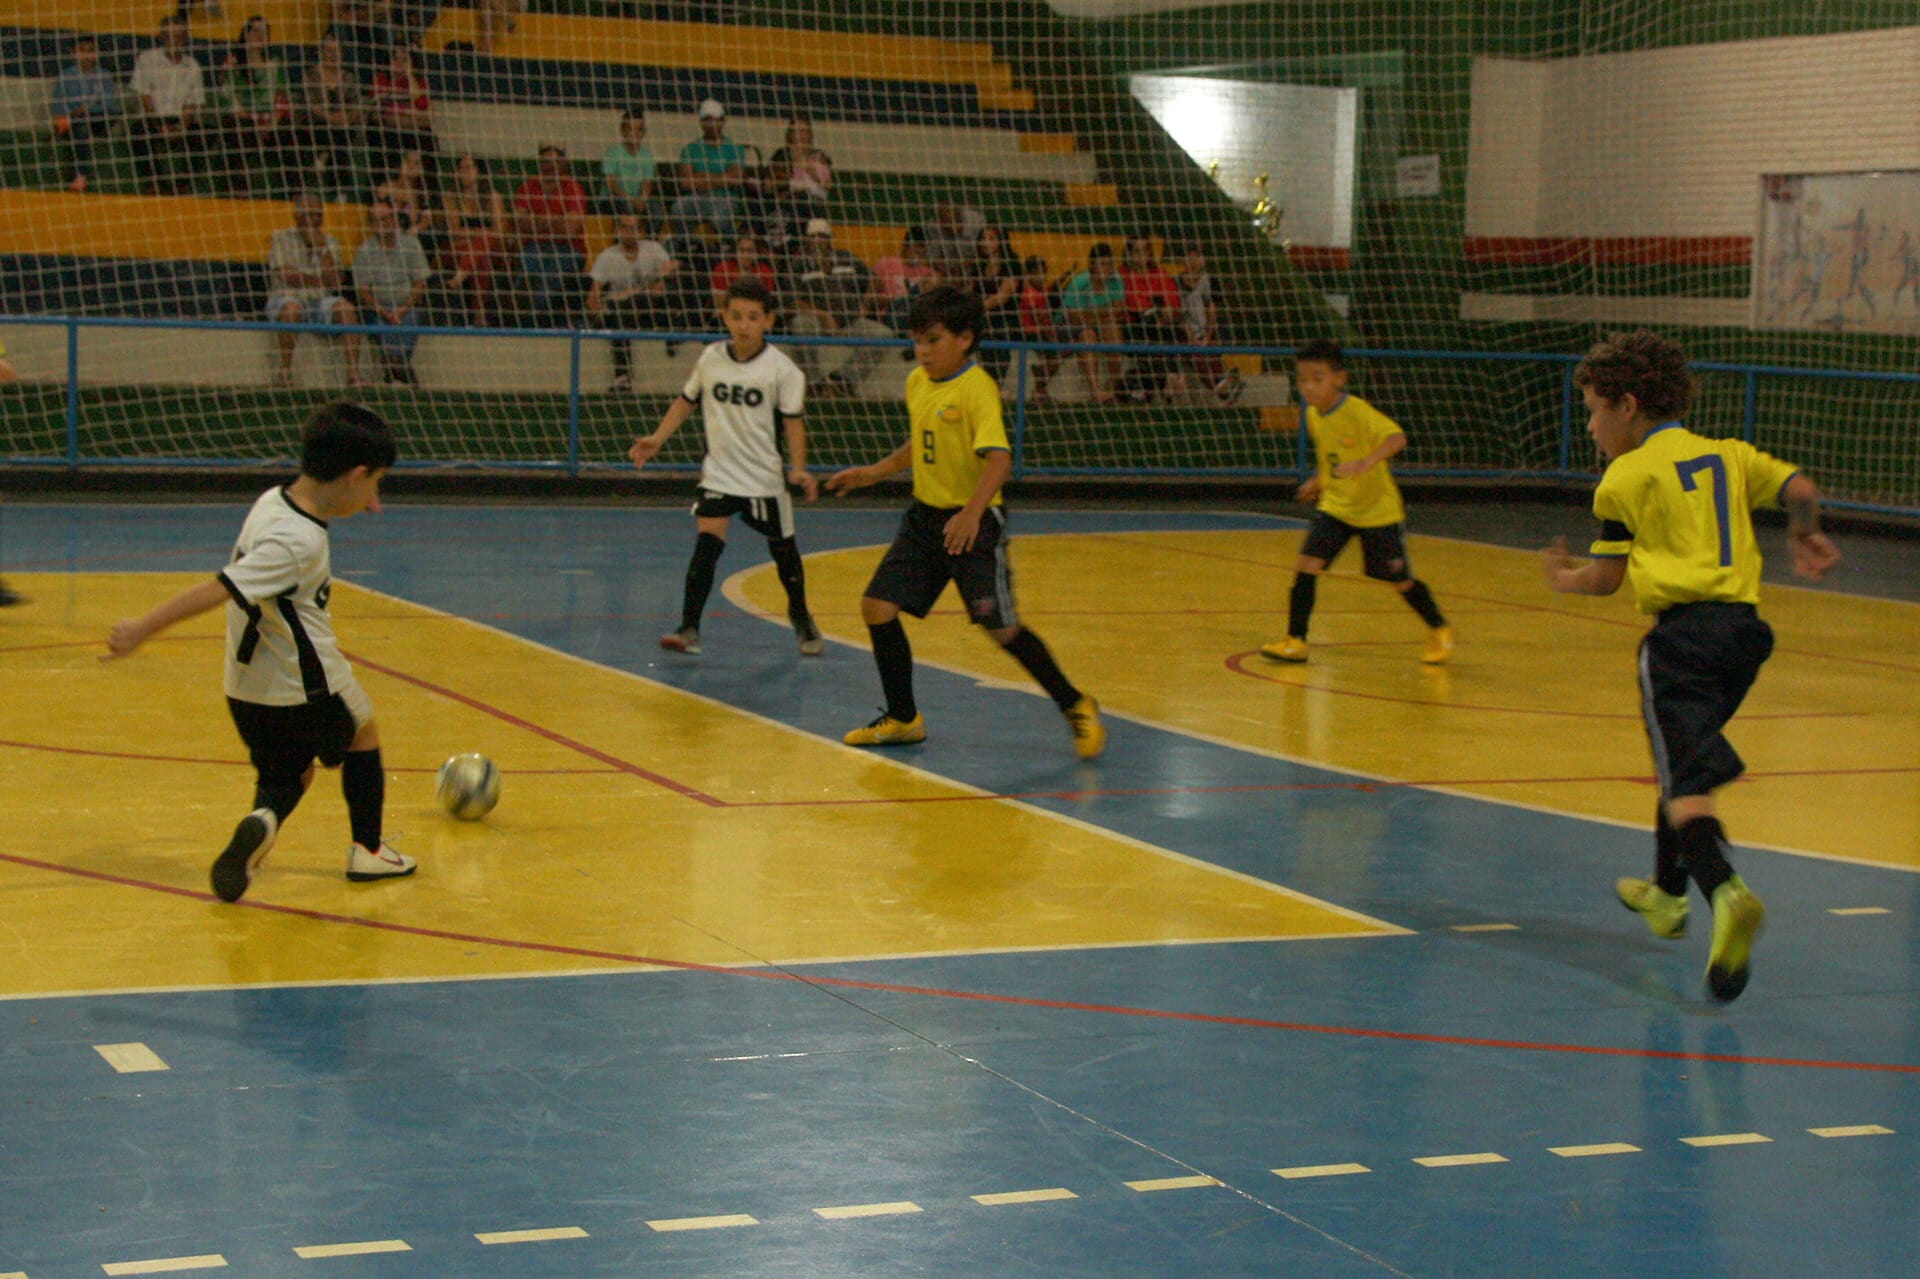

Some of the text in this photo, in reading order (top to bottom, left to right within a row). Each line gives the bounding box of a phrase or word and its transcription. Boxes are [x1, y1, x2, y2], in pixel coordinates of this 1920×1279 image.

[712, 382, 763, 408] GEO
[923, 429, 936, 465] 9
[1674, 453, 1732, 568] 7
